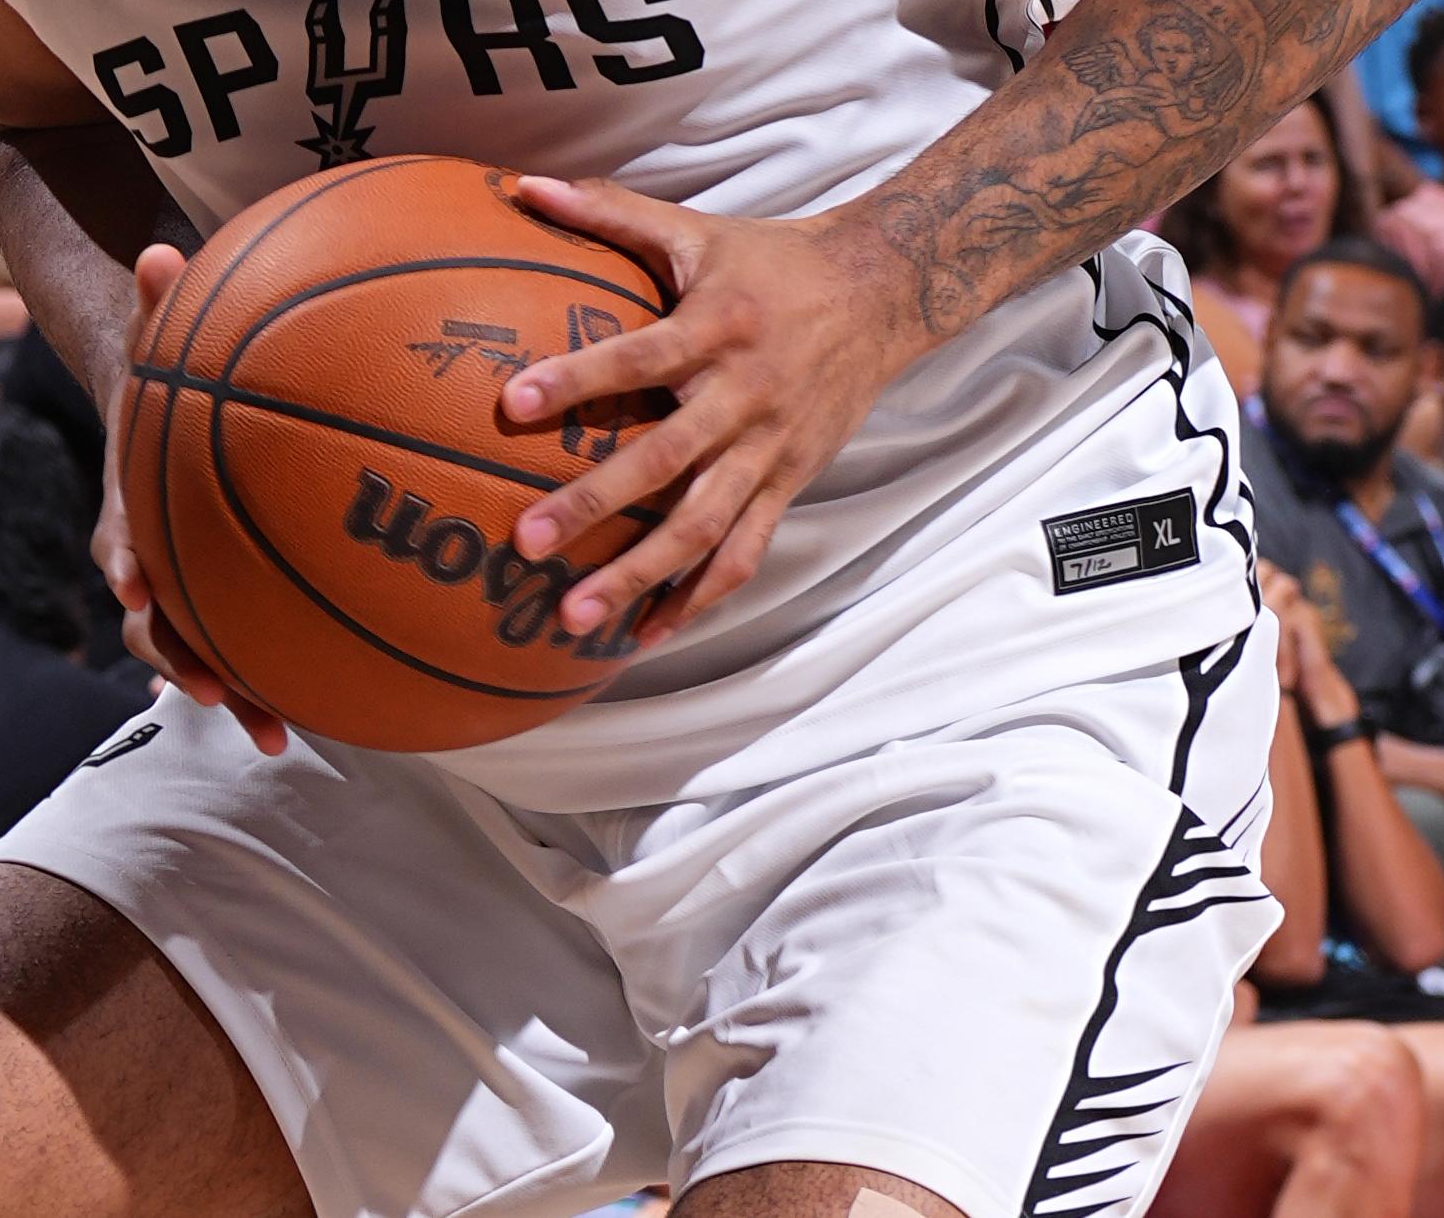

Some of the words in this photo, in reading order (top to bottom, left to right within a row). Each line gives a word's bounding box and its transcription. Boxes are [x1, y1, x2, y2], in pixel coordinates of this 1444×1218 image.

[1053, 512, 1135, 539] ENGINEERED
[1153, 517, 1182, 551] XL
[343, 466, 647, 662] Wlson
